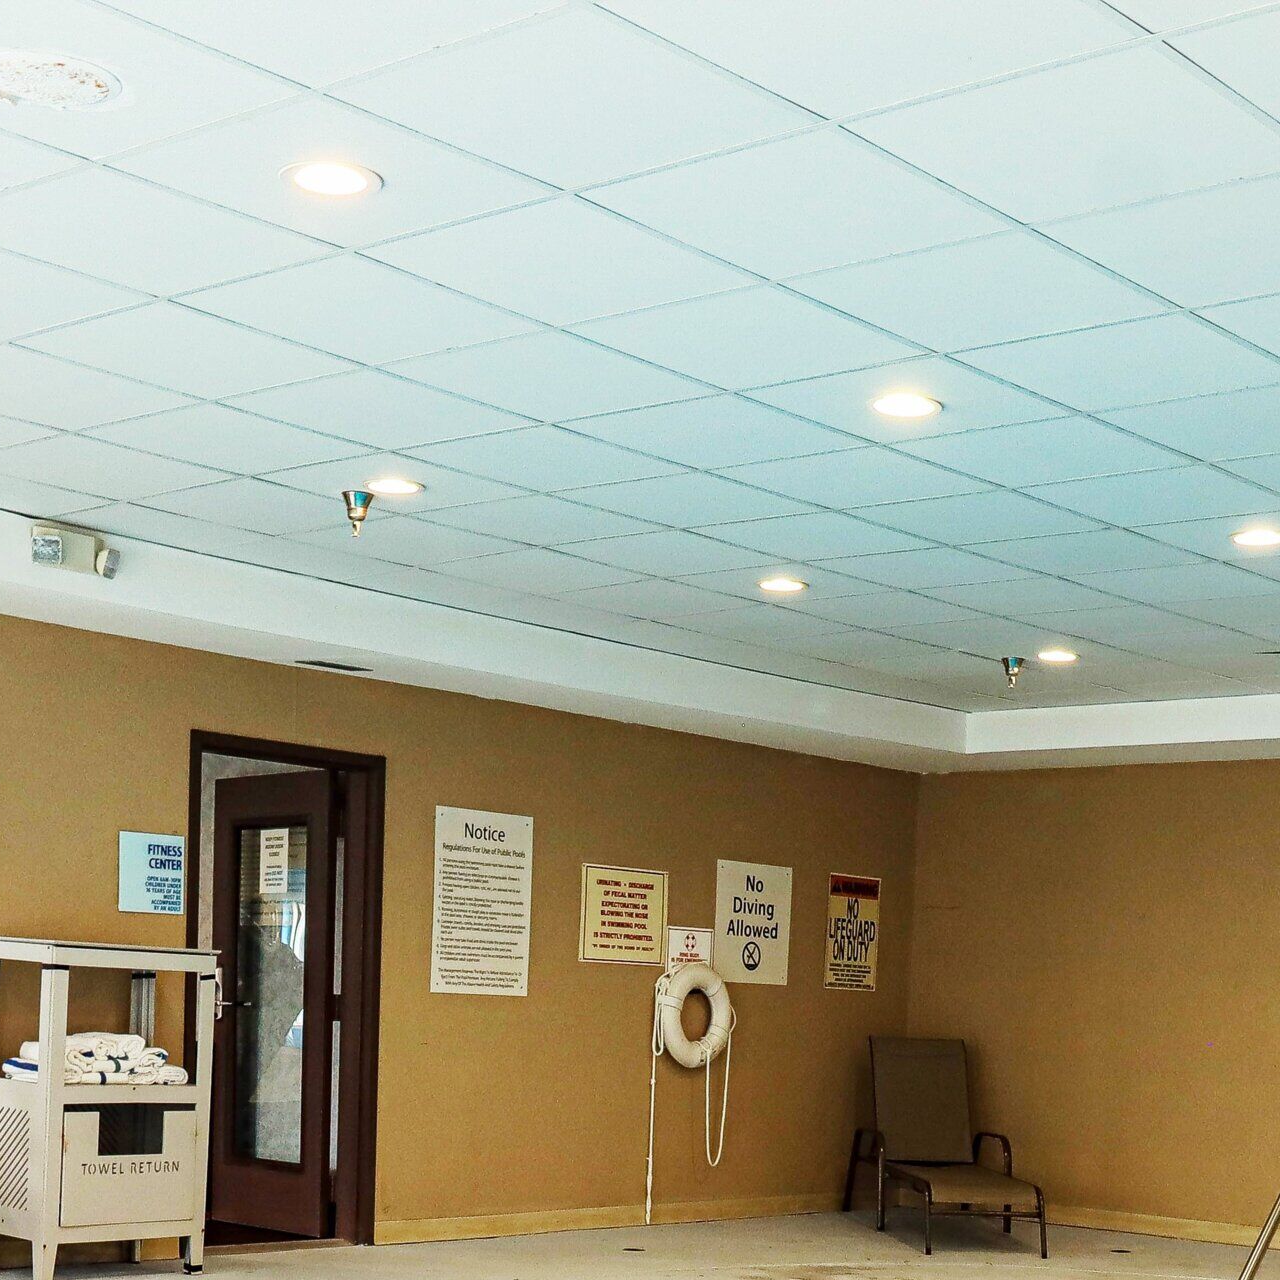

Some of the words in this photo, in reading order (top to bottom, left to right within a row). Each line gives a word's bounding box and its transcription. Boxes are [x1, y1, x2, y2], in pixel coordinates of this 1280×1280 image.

[464, 822, 506, 842] Notice
[148, 844, 182, 857] FITNESS
[442, 842, 472, 854] Regulations
[482, 847, 490, 855] Use
[497, 849, 511, 857] Public
[512, 850, 526, 858] Pools
[148, 858, 182, 870] CENTER
[746, 875, 763, 892] No
[733, 896, 774, 920] Diving
[847, 898, 859, 919] NO
[726, 920, 778, 939] Allowed
[829, 917, 875, 942] LIFEGUARD
[833, 940, 844, 960] ON
[847, 940, 870, 962] DUTY
[81, 1162, 124, 1175] TOWEL
[130, 1161, 180, 1174] RETURN
